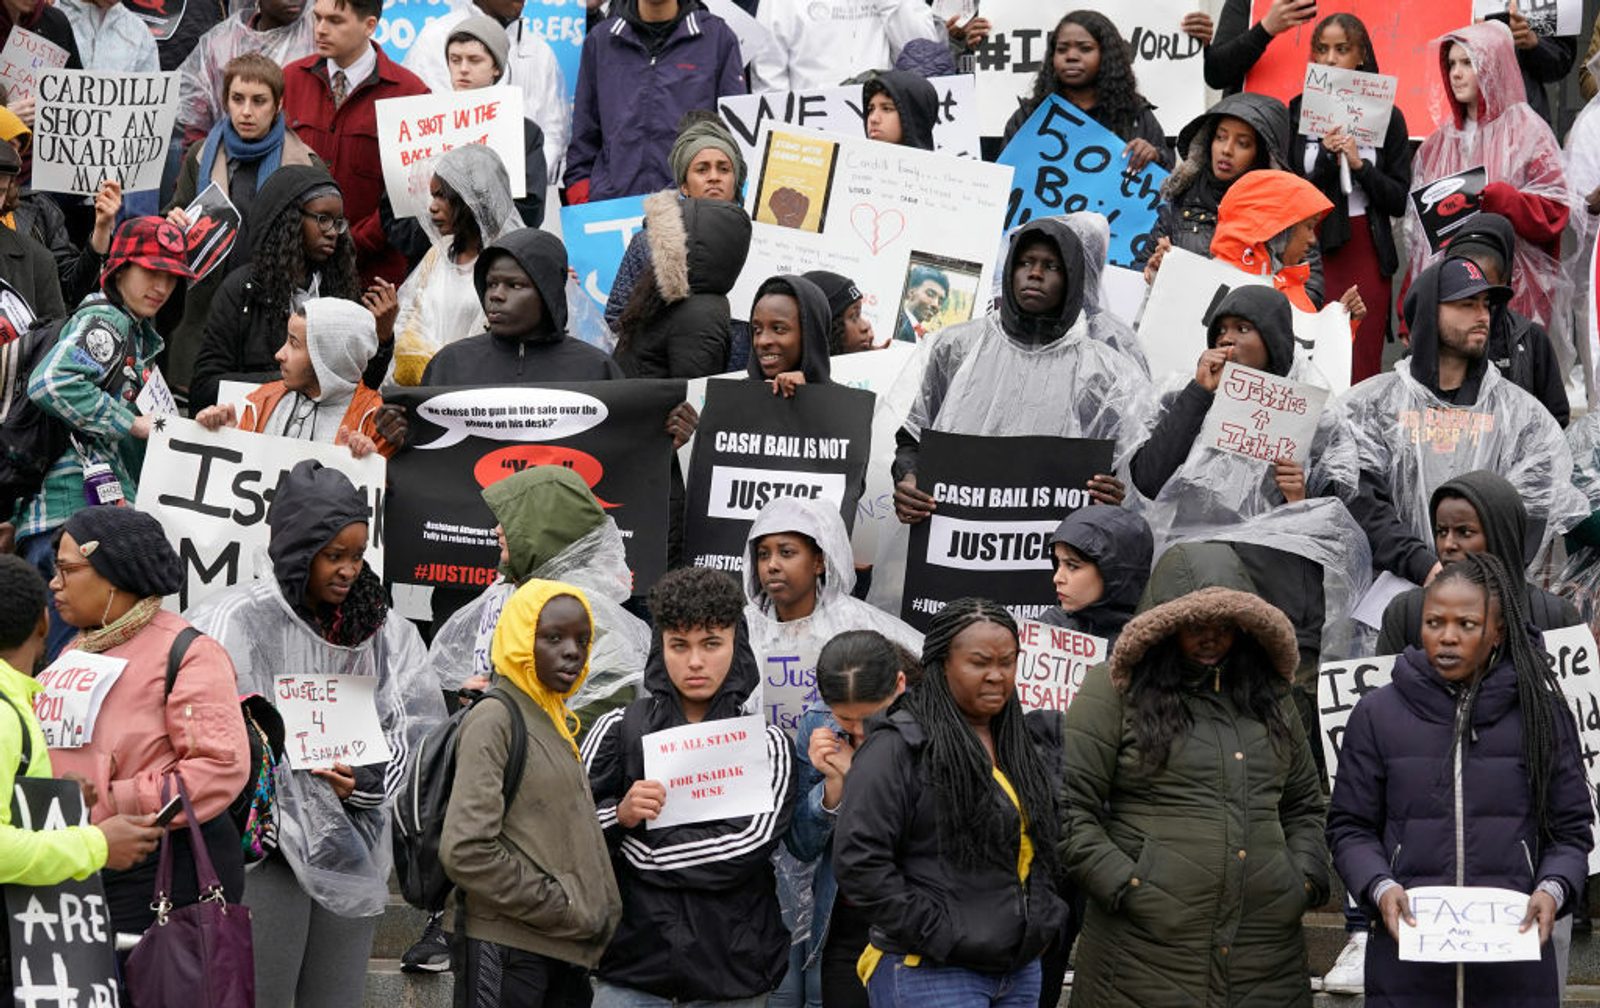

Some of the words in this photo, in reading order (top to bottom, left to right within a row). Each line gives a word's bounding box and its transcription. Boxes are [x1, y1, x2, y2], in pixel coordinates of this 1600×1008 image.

[39, 74, 171, 106] CARDILLI
[39, 105, 111, 138] SHOT
[121, 110, 158, 139] AN
[398, 119, 412, 143] A
[417, 113, 447, 138] SHOT
[474, 101, 501, 124] THE
[38, 133, 164, 167] UNARMED
[400, 146, 432, 167] BACK
[471, 406, 487, 417] the
[520, 405, 535, 415] the
[559, 406, 580, 415] over
[582, 405, 598, 415] the
[495, 420, 507, 429] on
[509, 419, 523, 428] his
[1251, 409, 1270, 431] 4
[715, 431, 762, 455] CASH
[764, 435, 800, 458] BAIL
[803, 437, 817, 459] IS
[819, 438, 850, 460] NOT
[934, 482, 985, 507] CASH
[989, 487, 1028, 508] BAIL
[1033, 486, 1050, 507] IS
[1055, 487, 1091, 508] NOT
[1051, 628, 1096, 657] NEED
[1018, 649, 1094, 687] USTIC
[1018, 682, 1078, 712] ISAH
[1319, 664, 1380, 715] If
[312, 711, 326, 734] 4
[660, 742, 677, 753] WE
[682, 737, 705, 750] ALL
[706, 730, 747, 747] STAND
[669, 776, 694, 788] FOR
[697, 766, 744, 782] ISAHAK
[691, 785, 725, 799] MUSE
[13, 892, 108, 945] ARE
[1412, 896, 1531, 926] FACTS
[1416, 933, 1514, 954] FACTS
